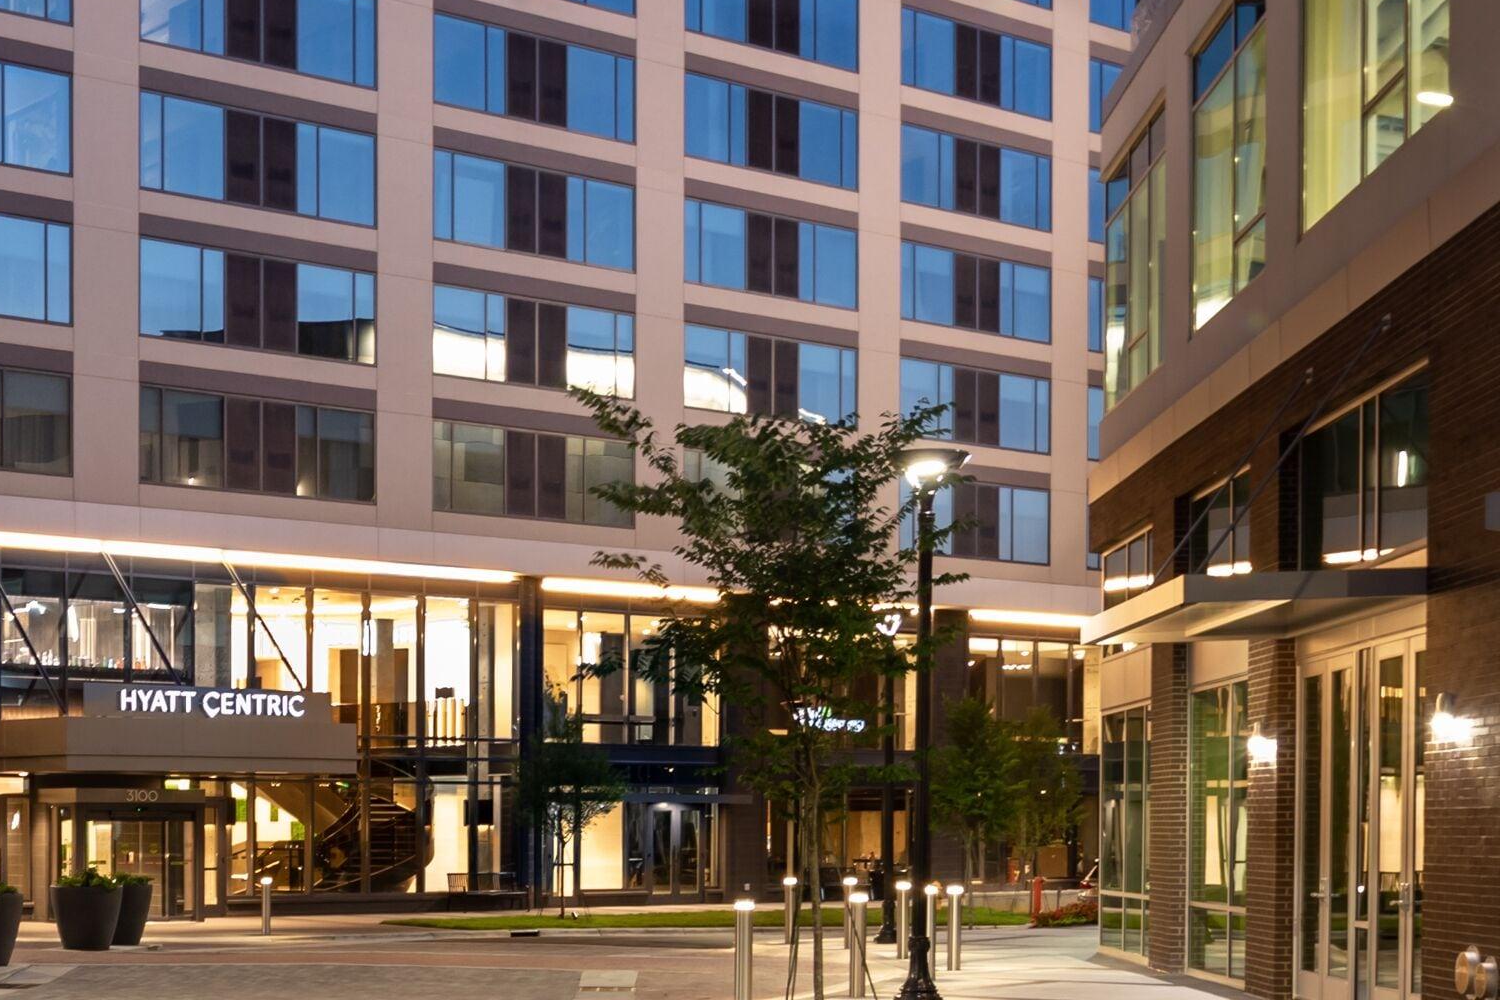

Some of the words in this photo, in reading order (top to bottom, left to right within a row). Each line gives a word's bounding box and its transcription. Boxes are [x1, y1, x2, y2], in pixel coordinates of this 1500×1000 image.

[120, 687, 198, 714] HYATT
[202, 690, 306, 719] CENTRIC
[125, 789, 159, 802] 3100
